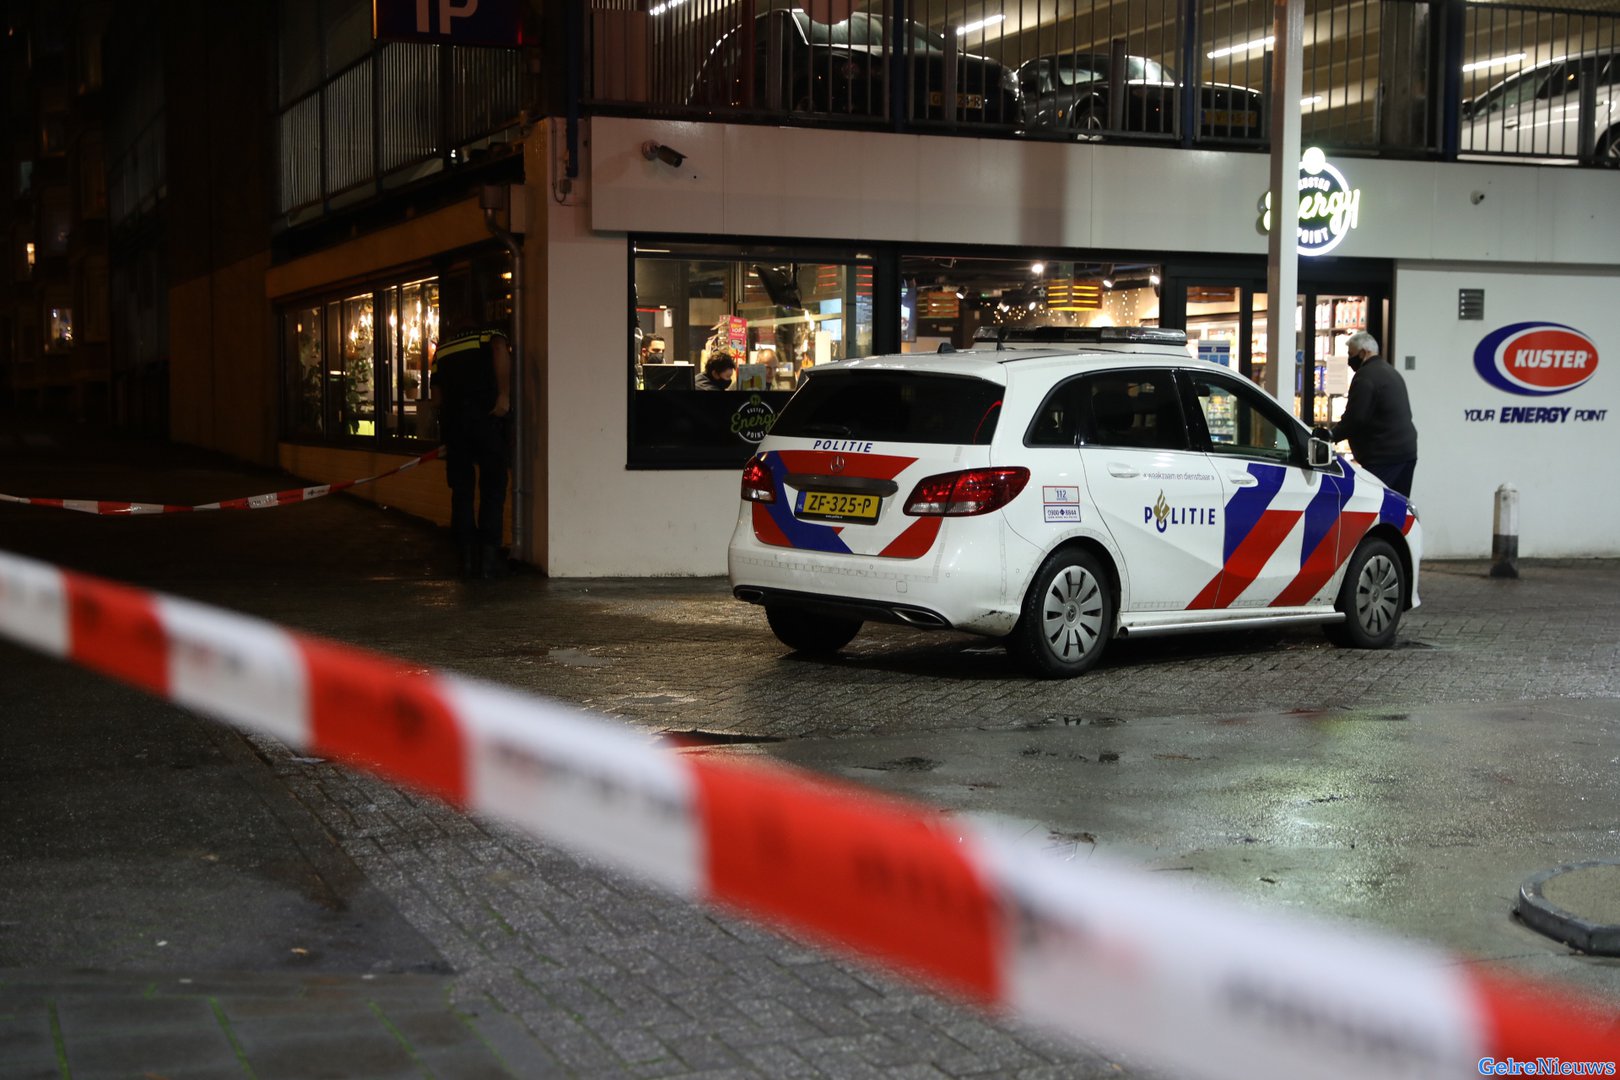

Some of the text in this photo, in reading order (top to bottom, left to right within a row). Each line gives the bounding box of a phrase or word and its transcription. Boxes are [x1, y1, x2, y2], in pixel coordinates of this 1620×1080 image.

[1514, 350, 1588, 369] KUSTER
[1464, 406, 1608, 424] YOUR ENERGY POINT
[813, 440, 873, 453] POLITIE
[1056, 490, 1067, 498] 112
[808, 495, 872, 514] ZF-325-P
[1144, 507, 1216, 533] POLITIE
